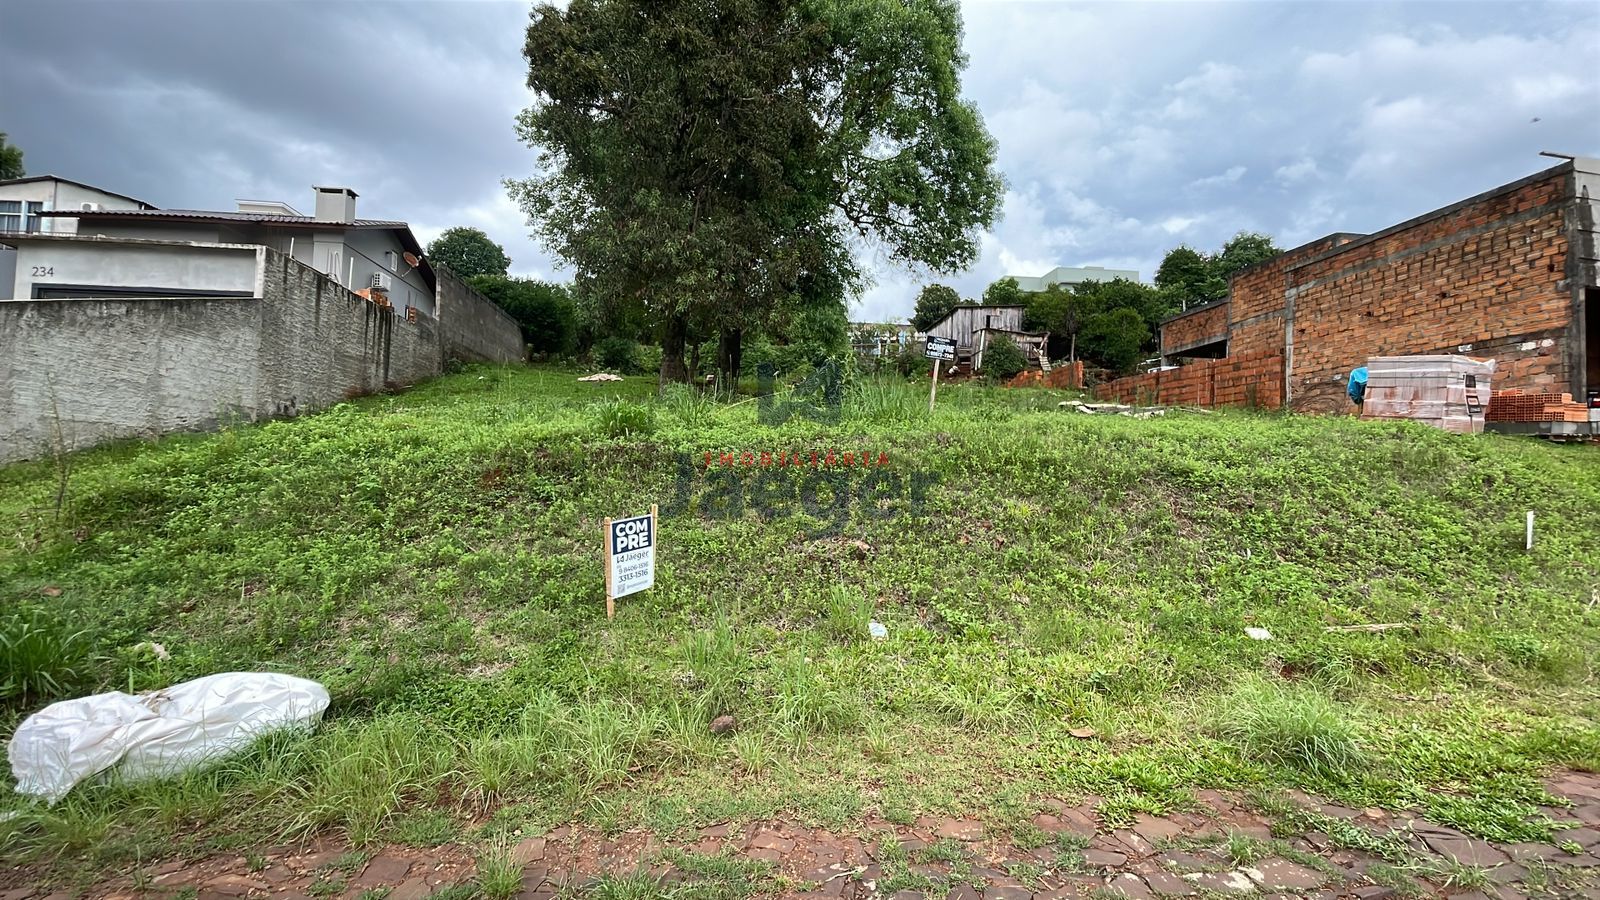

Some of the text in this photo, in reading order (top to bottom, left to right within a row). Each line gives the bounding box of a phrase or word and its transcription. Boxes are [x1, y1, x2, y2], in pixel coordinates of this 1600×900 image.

[31, 266, 54, 277] 234
[927, 342, 955, 353] COMPRE
[615, 519, 648, 537] COM
[616, 532, 649, 553] PRE
[625, 551, 649, 561] Jaeger
[618, 568, 649, 583] 3313-1516
